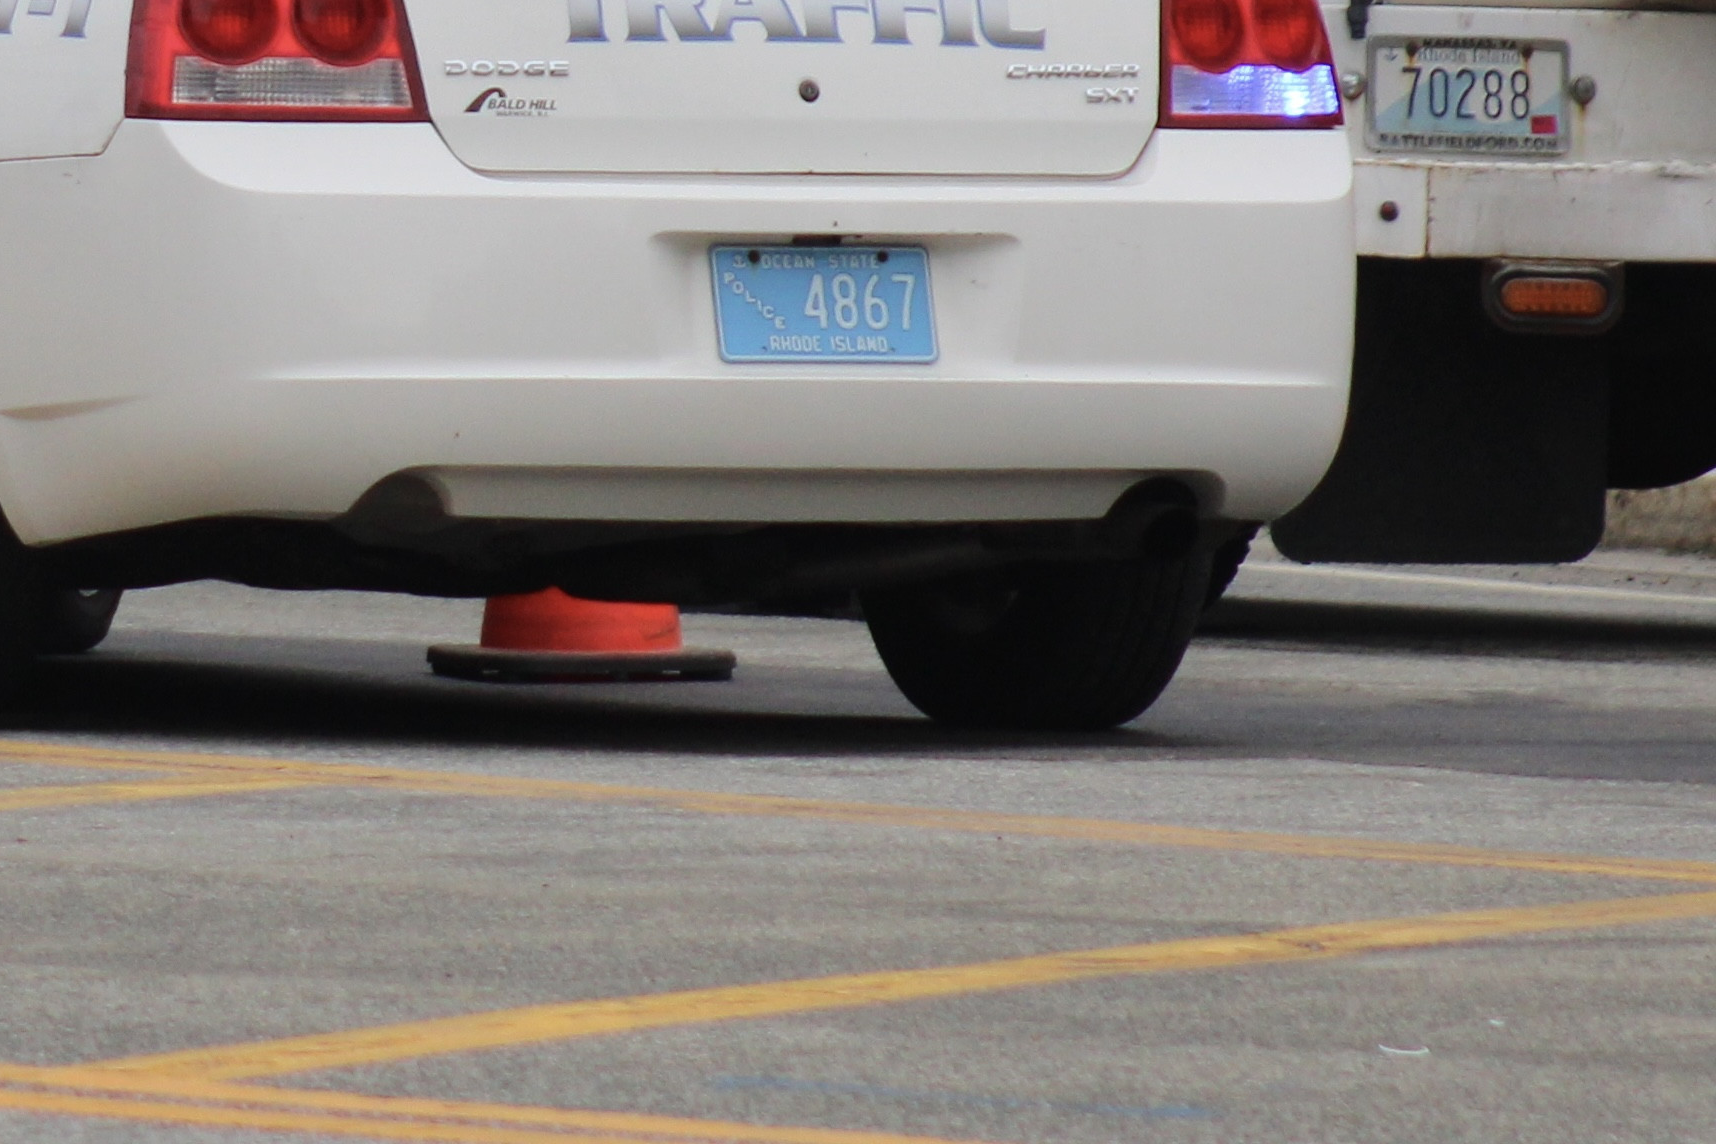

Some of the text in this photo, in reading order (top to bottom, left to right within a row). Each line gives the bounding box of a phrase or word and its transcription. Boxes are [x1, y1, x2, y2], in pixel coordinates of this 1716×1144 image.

[443, 59, 570, 76] DODGE
[1006, 63, 1140, 79] CHARGER
[1085, 87, 1140, 103] SXT
[1402, 66, 1530, 120] 70288
[487, 98, 557, 111] BALD HILL
[760, 254, 881, 269] OCEAN STATE
[723, 272, 786, 329] POLICE
[804, 273, 917, 331] 4867
[769, 335, 889, 353] RHODE ISLAND
